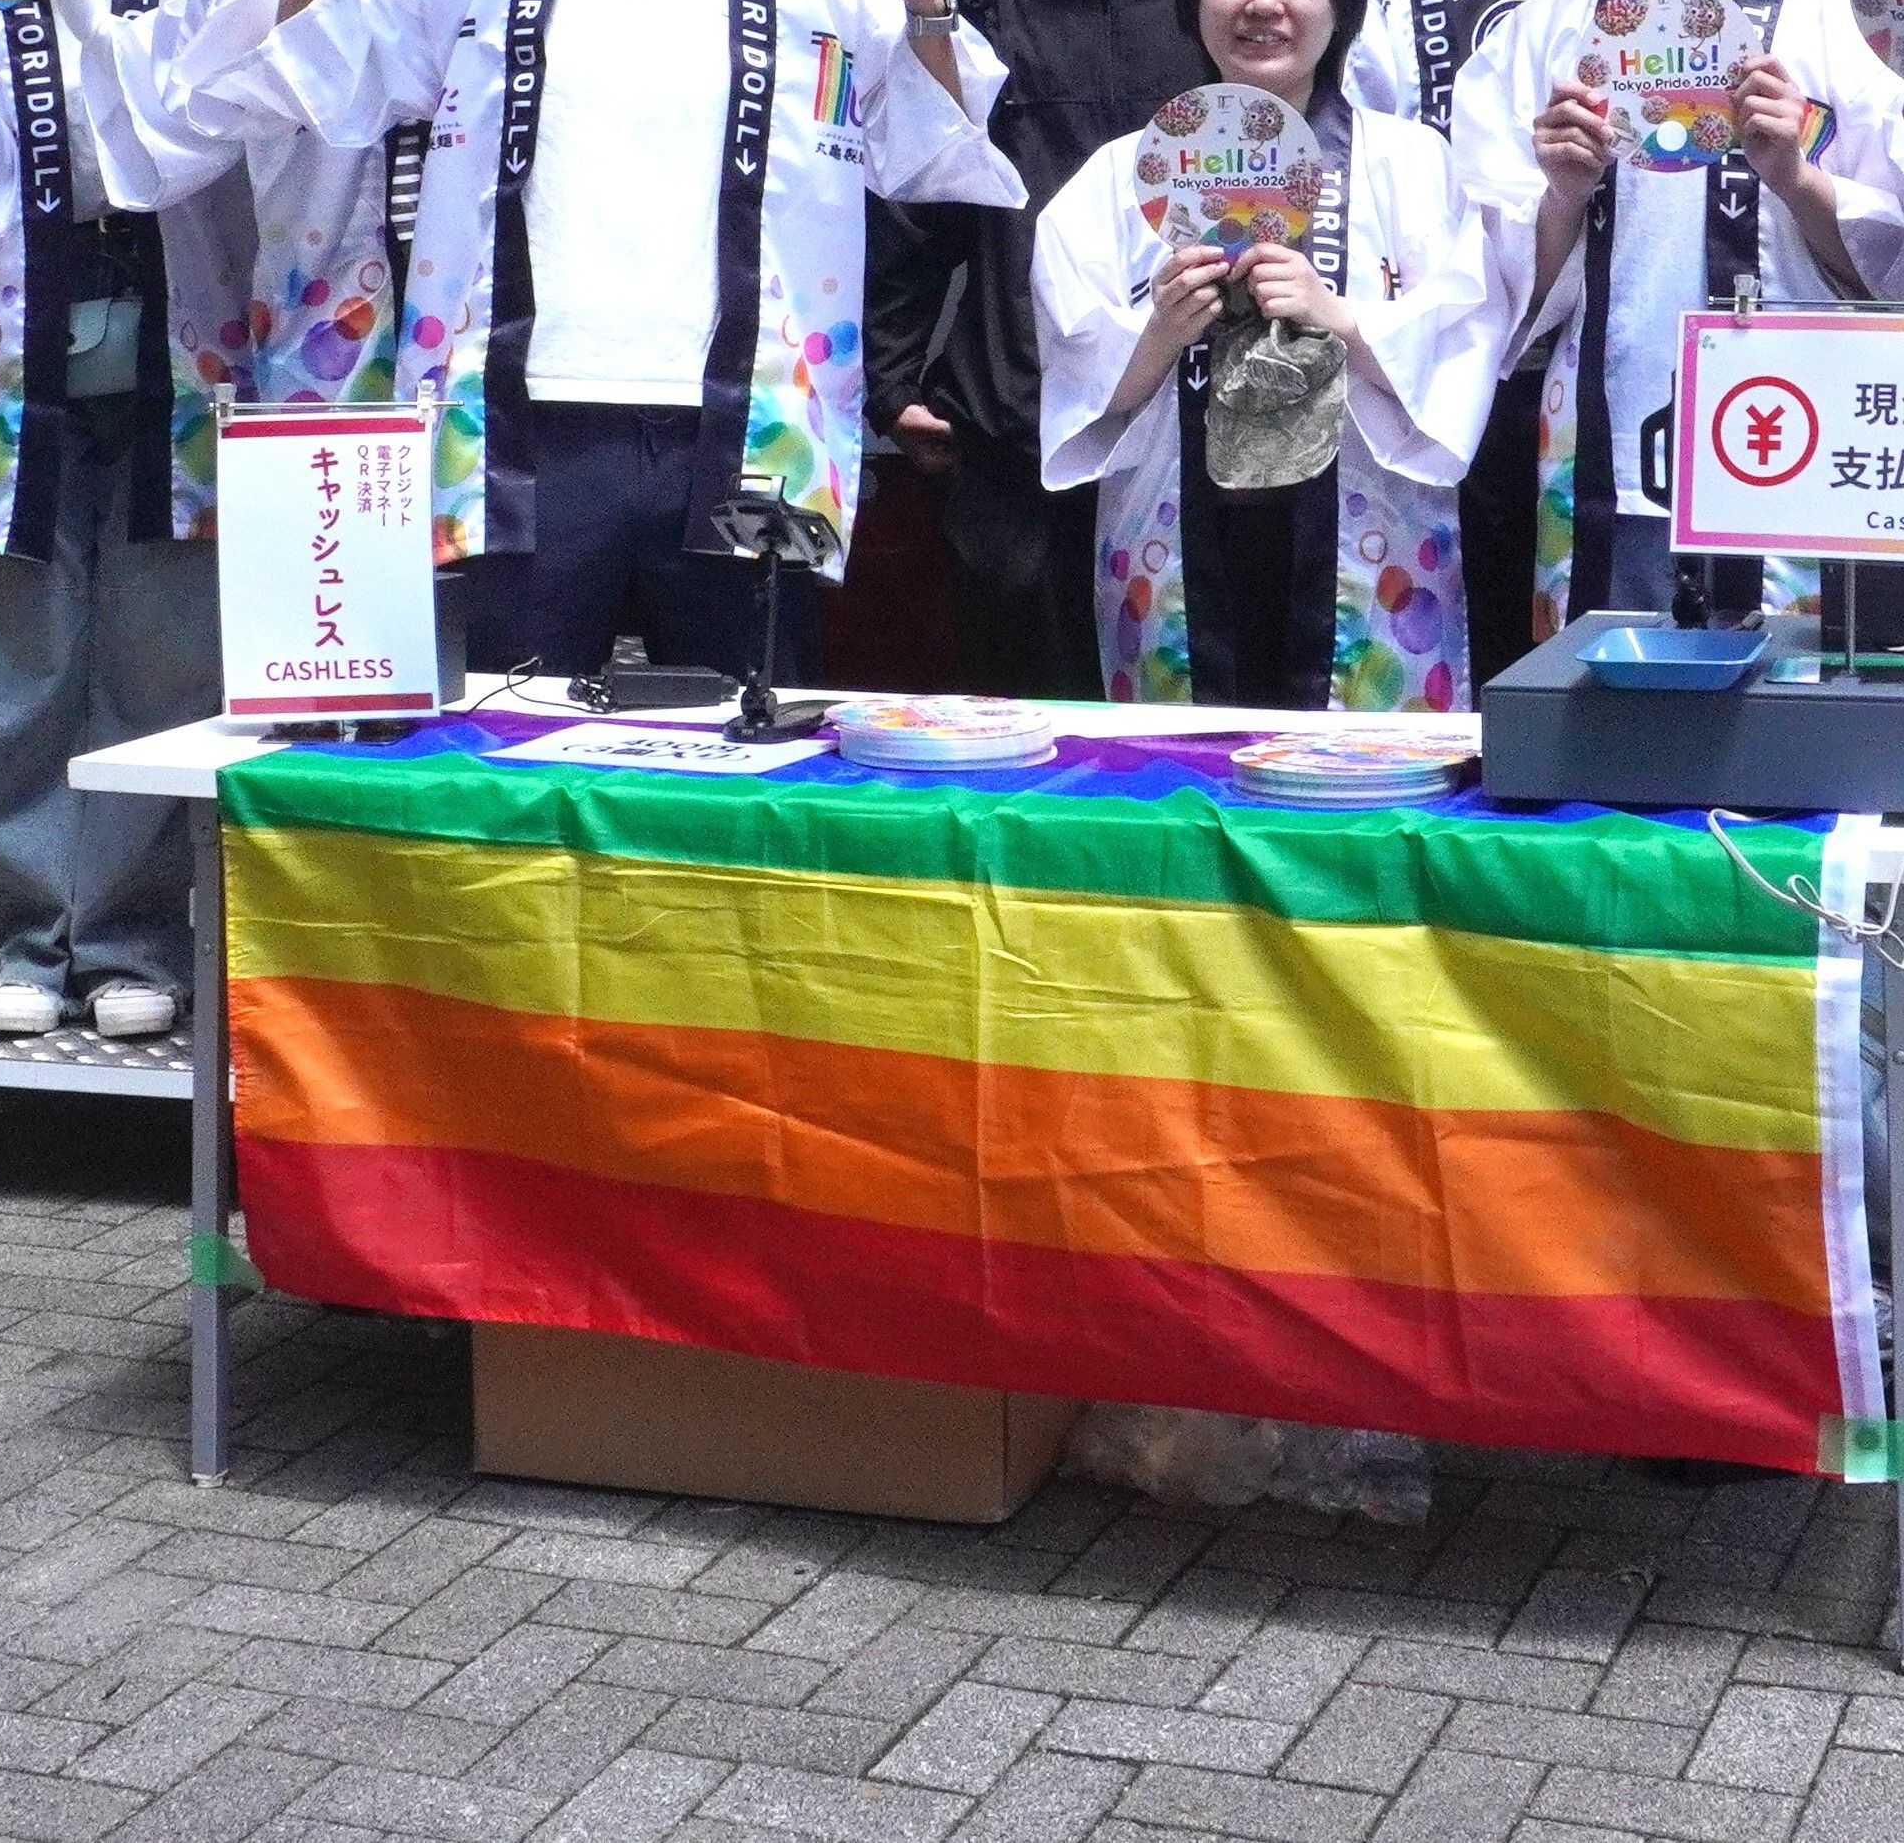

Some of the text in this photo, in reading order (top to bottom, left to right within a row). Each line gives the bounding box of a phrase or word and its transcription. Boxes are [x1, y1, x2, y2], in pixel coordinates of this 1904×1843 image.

[1620, 45, 1719, 76] Hello!
[13, 0, 60, 186] TORIDOLL
[1613, 75, 1728, 93] Tokyo Pride 2026
[1178, 147, 1278, 174] Hello!
[1172, 175, 1286, 190] Tokyo Pride 2026
[376, 445, 392, 527] 電子マネー
[398, 445, 412, 527] クレジット
[311, 447, 344, 647] キャッシュレス
[266, 658, 393, 681] CASHLESS
